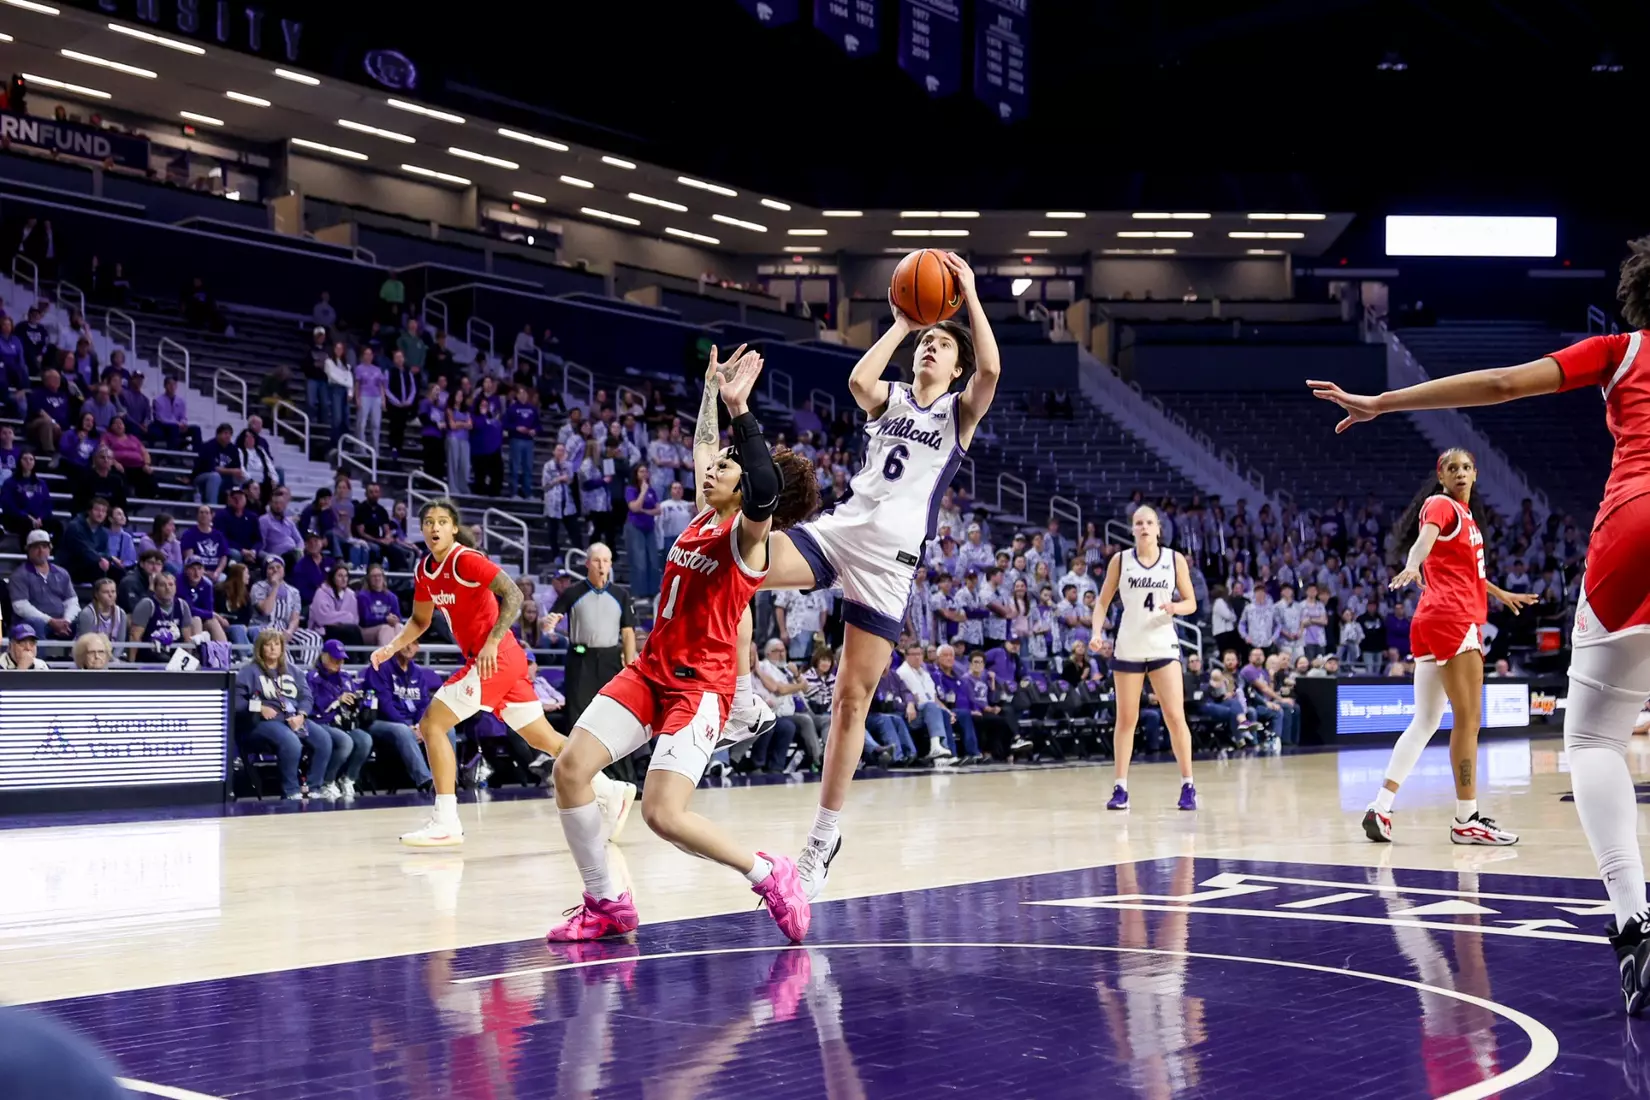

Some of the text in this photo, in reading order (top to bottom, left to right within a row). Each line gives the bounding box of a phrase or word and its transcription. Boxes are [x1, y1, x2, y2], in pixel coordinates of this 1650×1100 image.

[0, 113, 112, 158] RNFUND
[876, 417, 943, 450] Wildcats
[882, 444, 910, 482] 6
[661, 575, 681, 620] 1
[1128, 576, 1169, 589] Wildcats
[1143, 592, 1155, 612] 4
